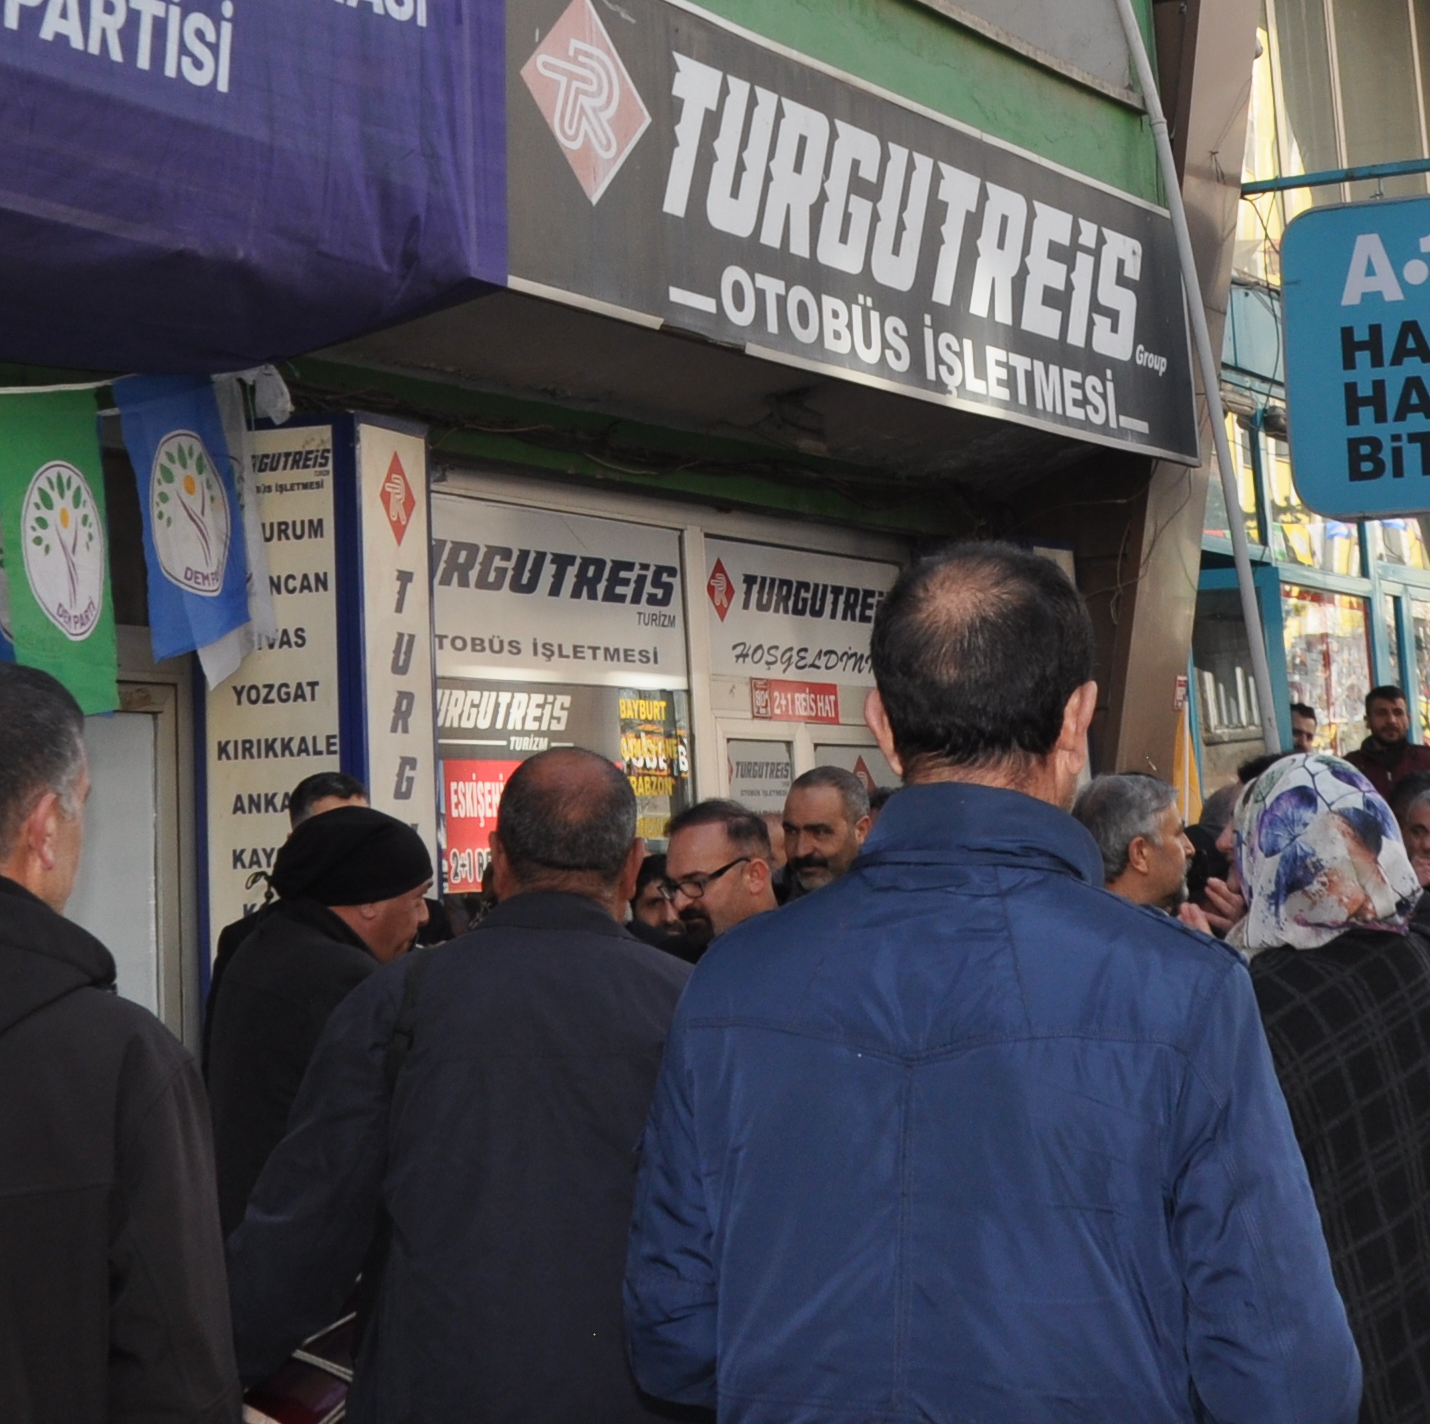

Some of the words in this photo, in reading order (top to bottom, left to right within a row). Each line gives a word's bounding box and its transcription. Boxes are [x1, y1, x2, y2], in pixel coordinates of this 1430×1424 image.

[720, 266, 911, 373] OTOBÜS
[924, 313, 1118, 430] İŞLETMESİ
[1134, 343, 1168, 376] Group
[261, 518, 324, 543] URUM
[269, 571, 329, 596] NCAN
[636, 610, 676, 628] TURİZM
[434, 634, 522, 656] TOBÜS
[532, 637, 659, 665] İŞLETMESİ
[232, 681, 319, 706] YOZGAT
[773, 692, 793, 715] 2+1
[795, 687, 816, 717] REİS
[817, 696, 836, 717] HAT
[436, 688, 571, 731] URGUTREiS
[619, 698, 667, 721] BAYBURT
[217, 734, 339, 761] KIRIKKALE
[509, 734, 549, 751] TURİZM
[628, 775, 675, 797] RABZON
[232, 791, 292, 815] ANKA
[450, 772, 504, 828] ESKİŞEH
